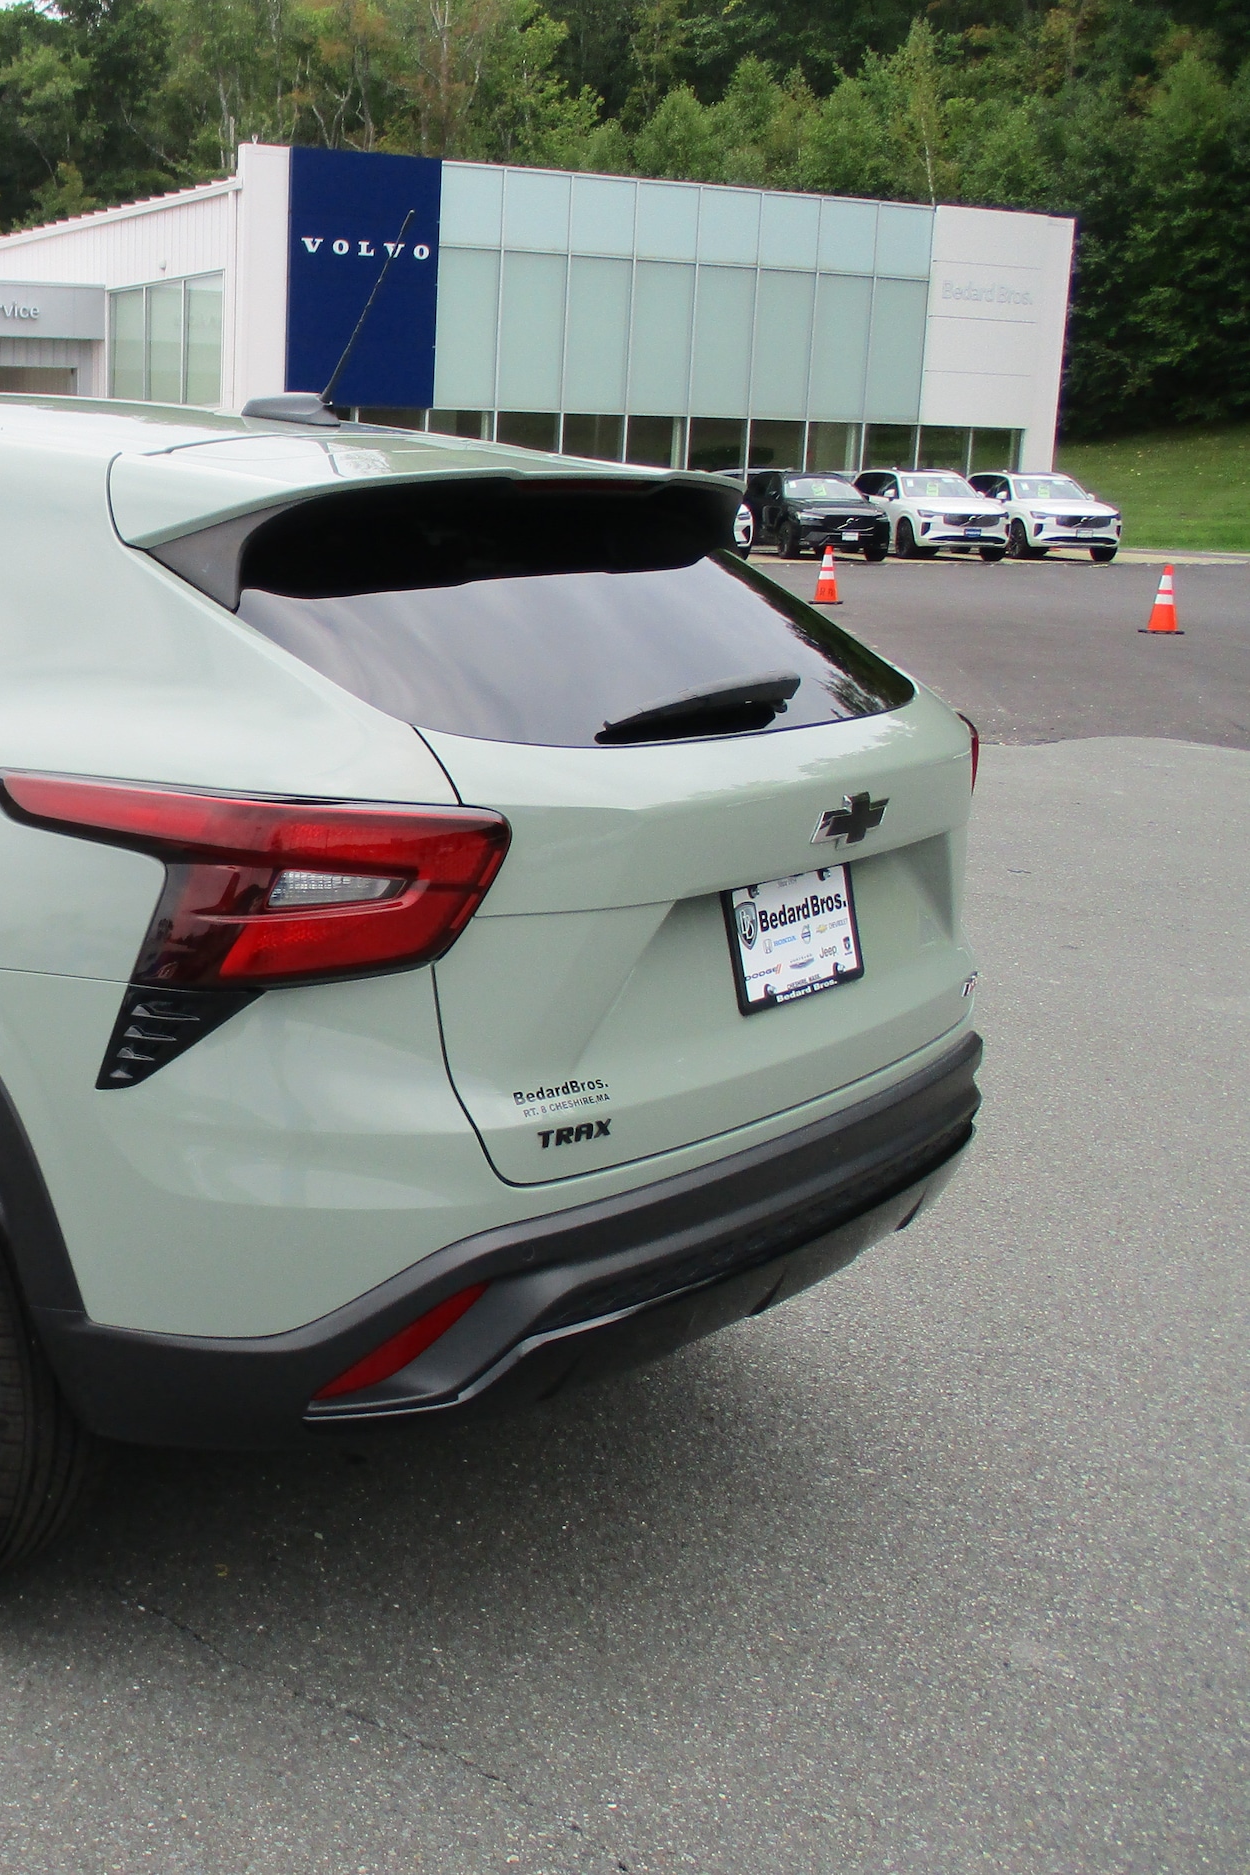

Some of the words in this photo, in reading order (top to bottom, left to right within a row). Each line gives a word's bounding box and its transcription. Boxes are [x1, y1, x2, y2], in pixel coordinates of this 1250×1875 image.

[301, 236, 430, 261] VOLVO
[941, 280, 995, 302] Bedard
[773, 935, 797, 947] HONDA
[819, 945, 838, 958] Jeep
[744, 967, 778, 982] DODGE
[776, 985, 811, 1003] Bedard
[813, 979, 838, 991] Bros.
[523, 1107, 540, 1118] RT.
[541, 1105, 548, 1114] 8
[537, 1118, 612, 1149] TRAX
